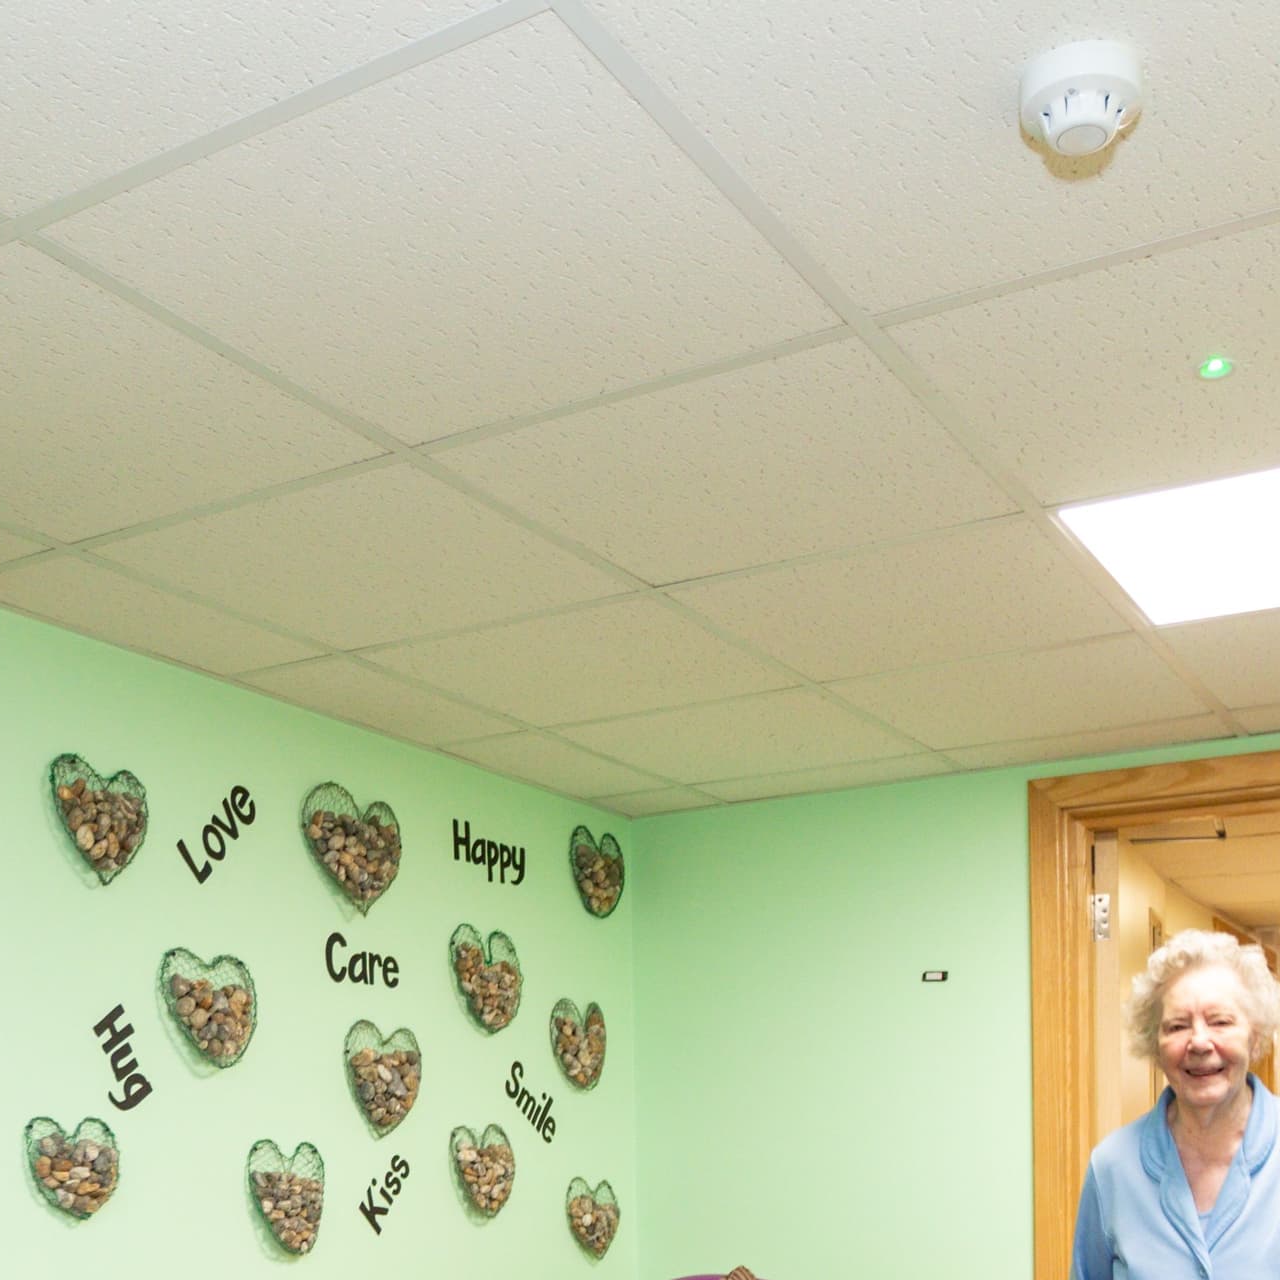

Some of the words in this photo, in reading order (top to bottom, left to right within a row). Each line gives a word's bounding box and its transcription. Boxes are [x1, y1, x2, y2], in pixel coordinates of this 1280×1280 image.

[176, 784, 257, 885] Love
[451, 818, 526, 886] Happy
[324, 932, 400, 988] Care
[92, 1004, 154, 1112] Hug
[504, 1061, 558, 1144] Smile
[358, 1153, 412, 1236] Kiss
